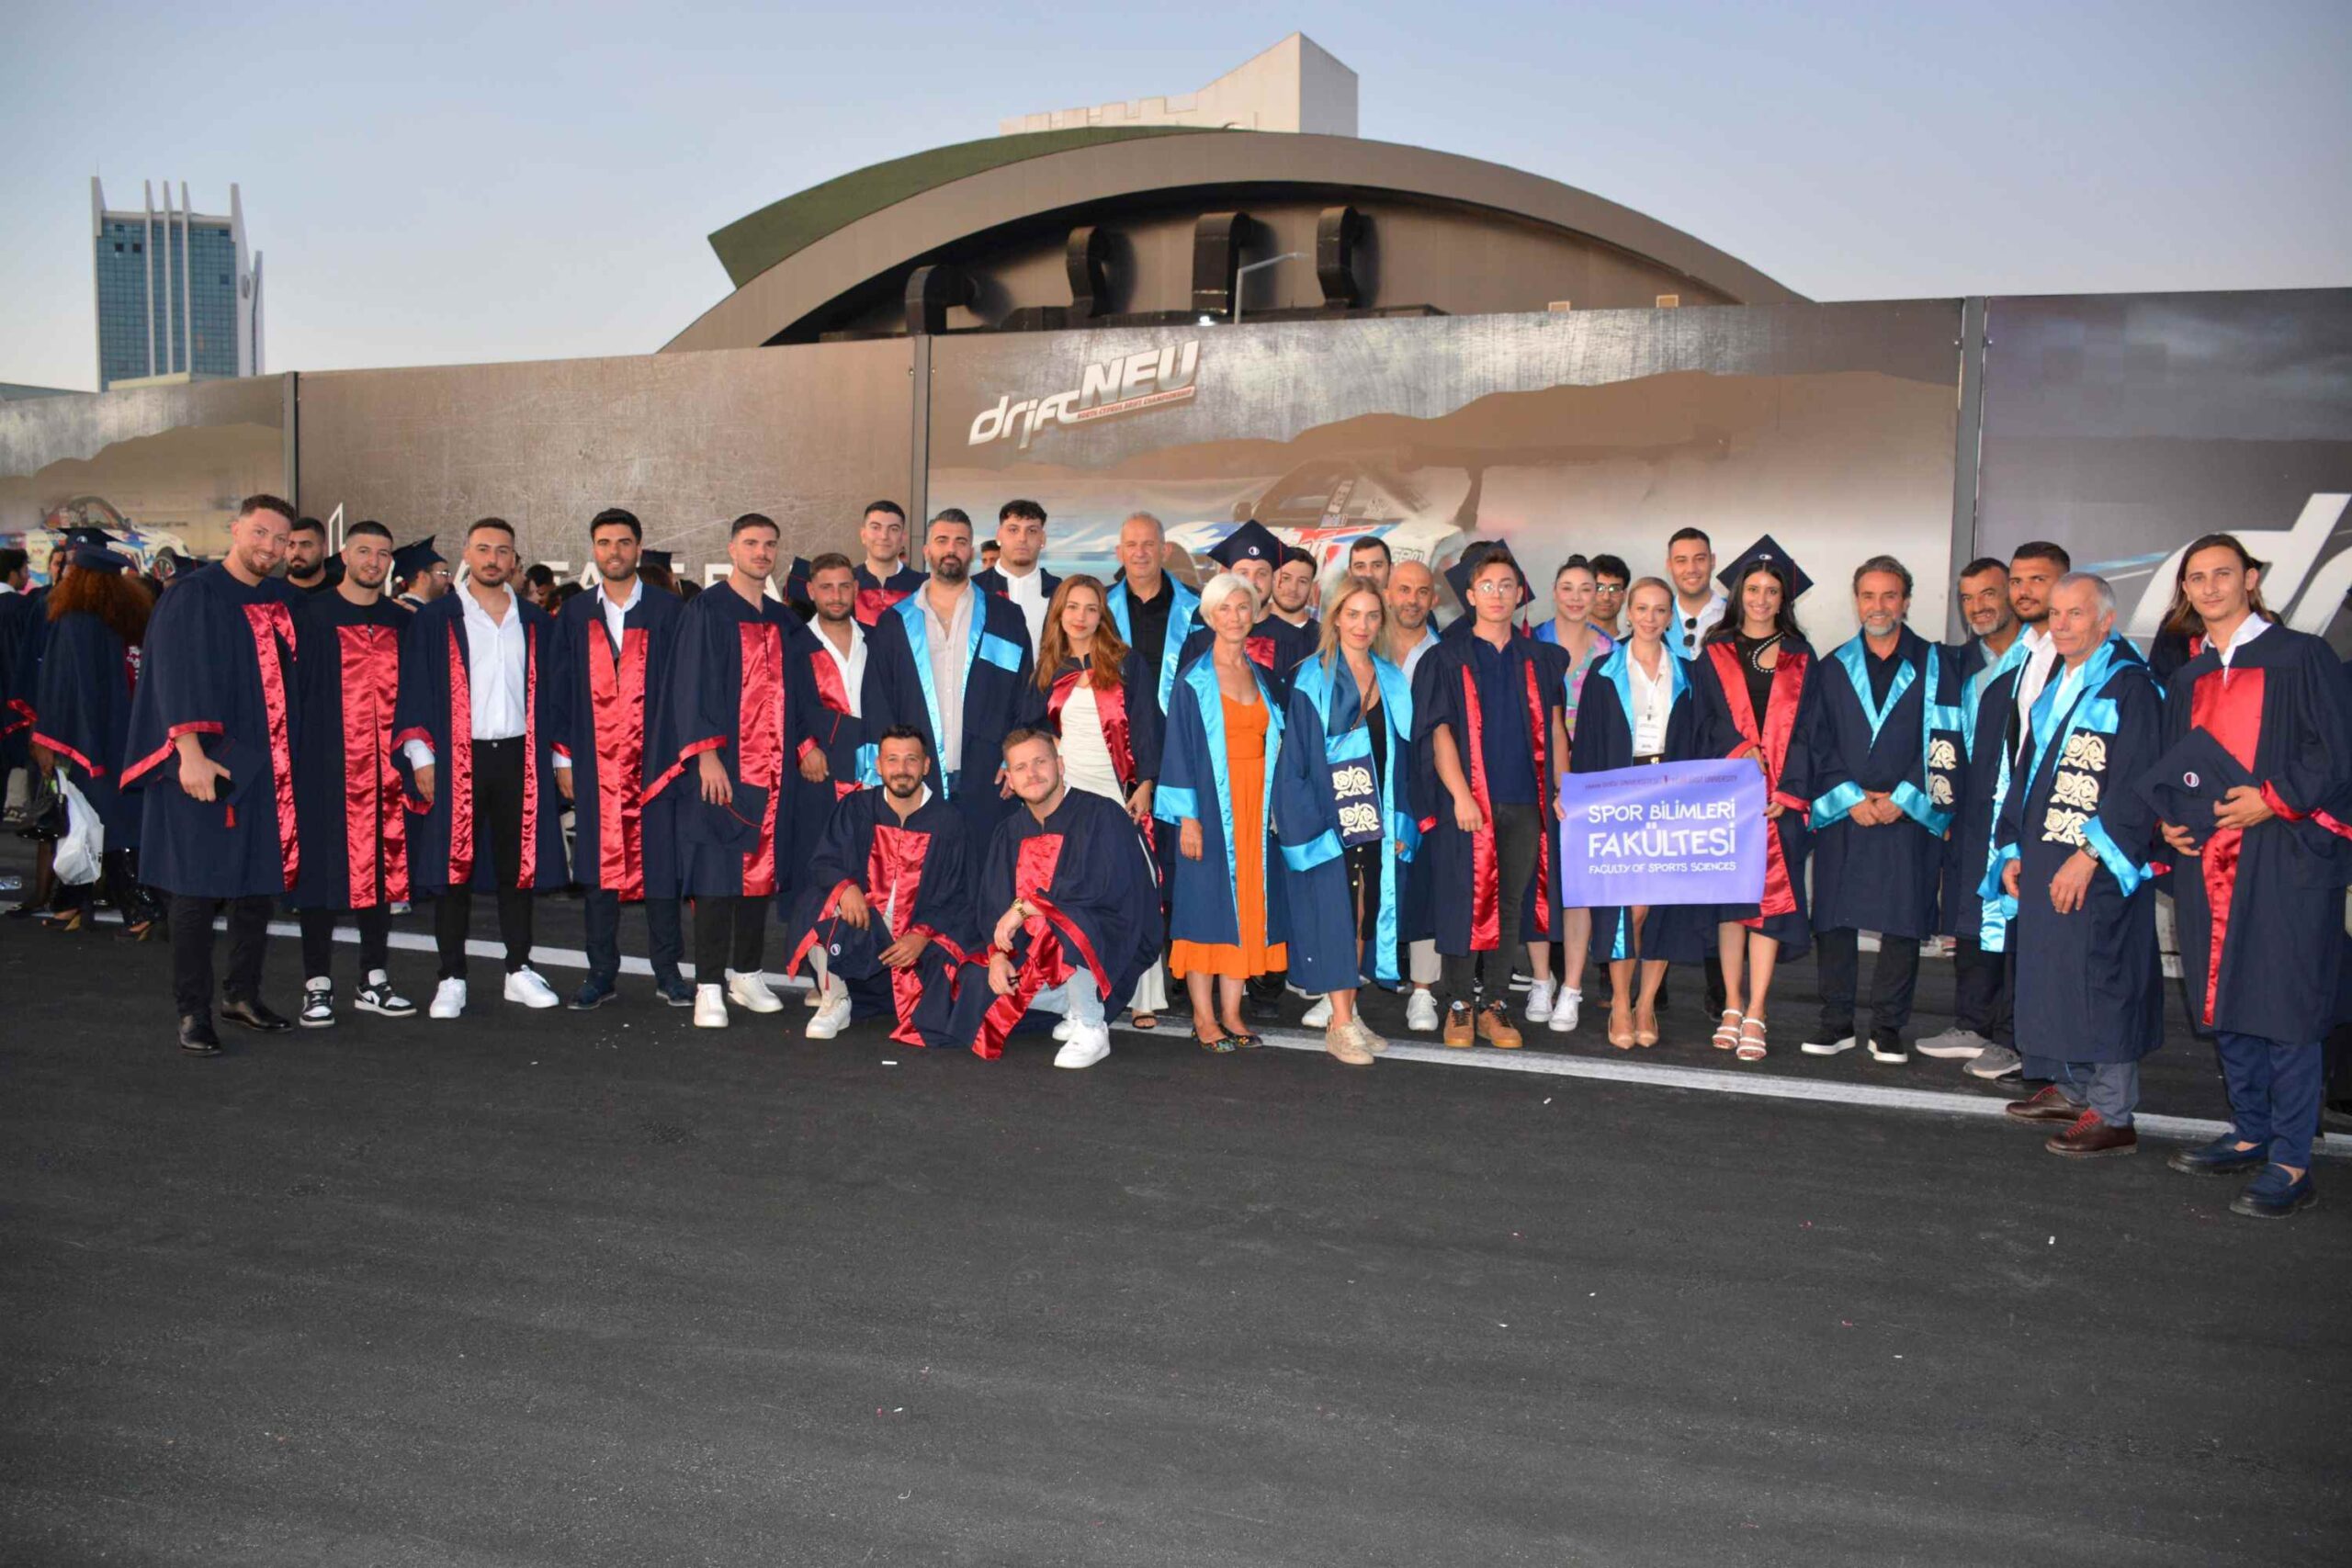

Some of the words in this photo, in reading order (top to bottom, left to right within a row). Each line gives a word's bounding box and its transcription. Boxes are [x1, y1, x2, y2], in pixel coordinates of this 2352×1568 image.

[1588, 805, 1643, 823] SPOR
[1649, 797, 1736, 820] BİLİMLERİ
[1588, 821, 1736, 858] FAKÜLTESİ
[1589, 863, 1631, 874] FACULTY
[1632, 863, 1645, 873] OF
[1648, 863, 1688, 873] SPORTS
[1690, 862, 1736, 872] SCIENCES
